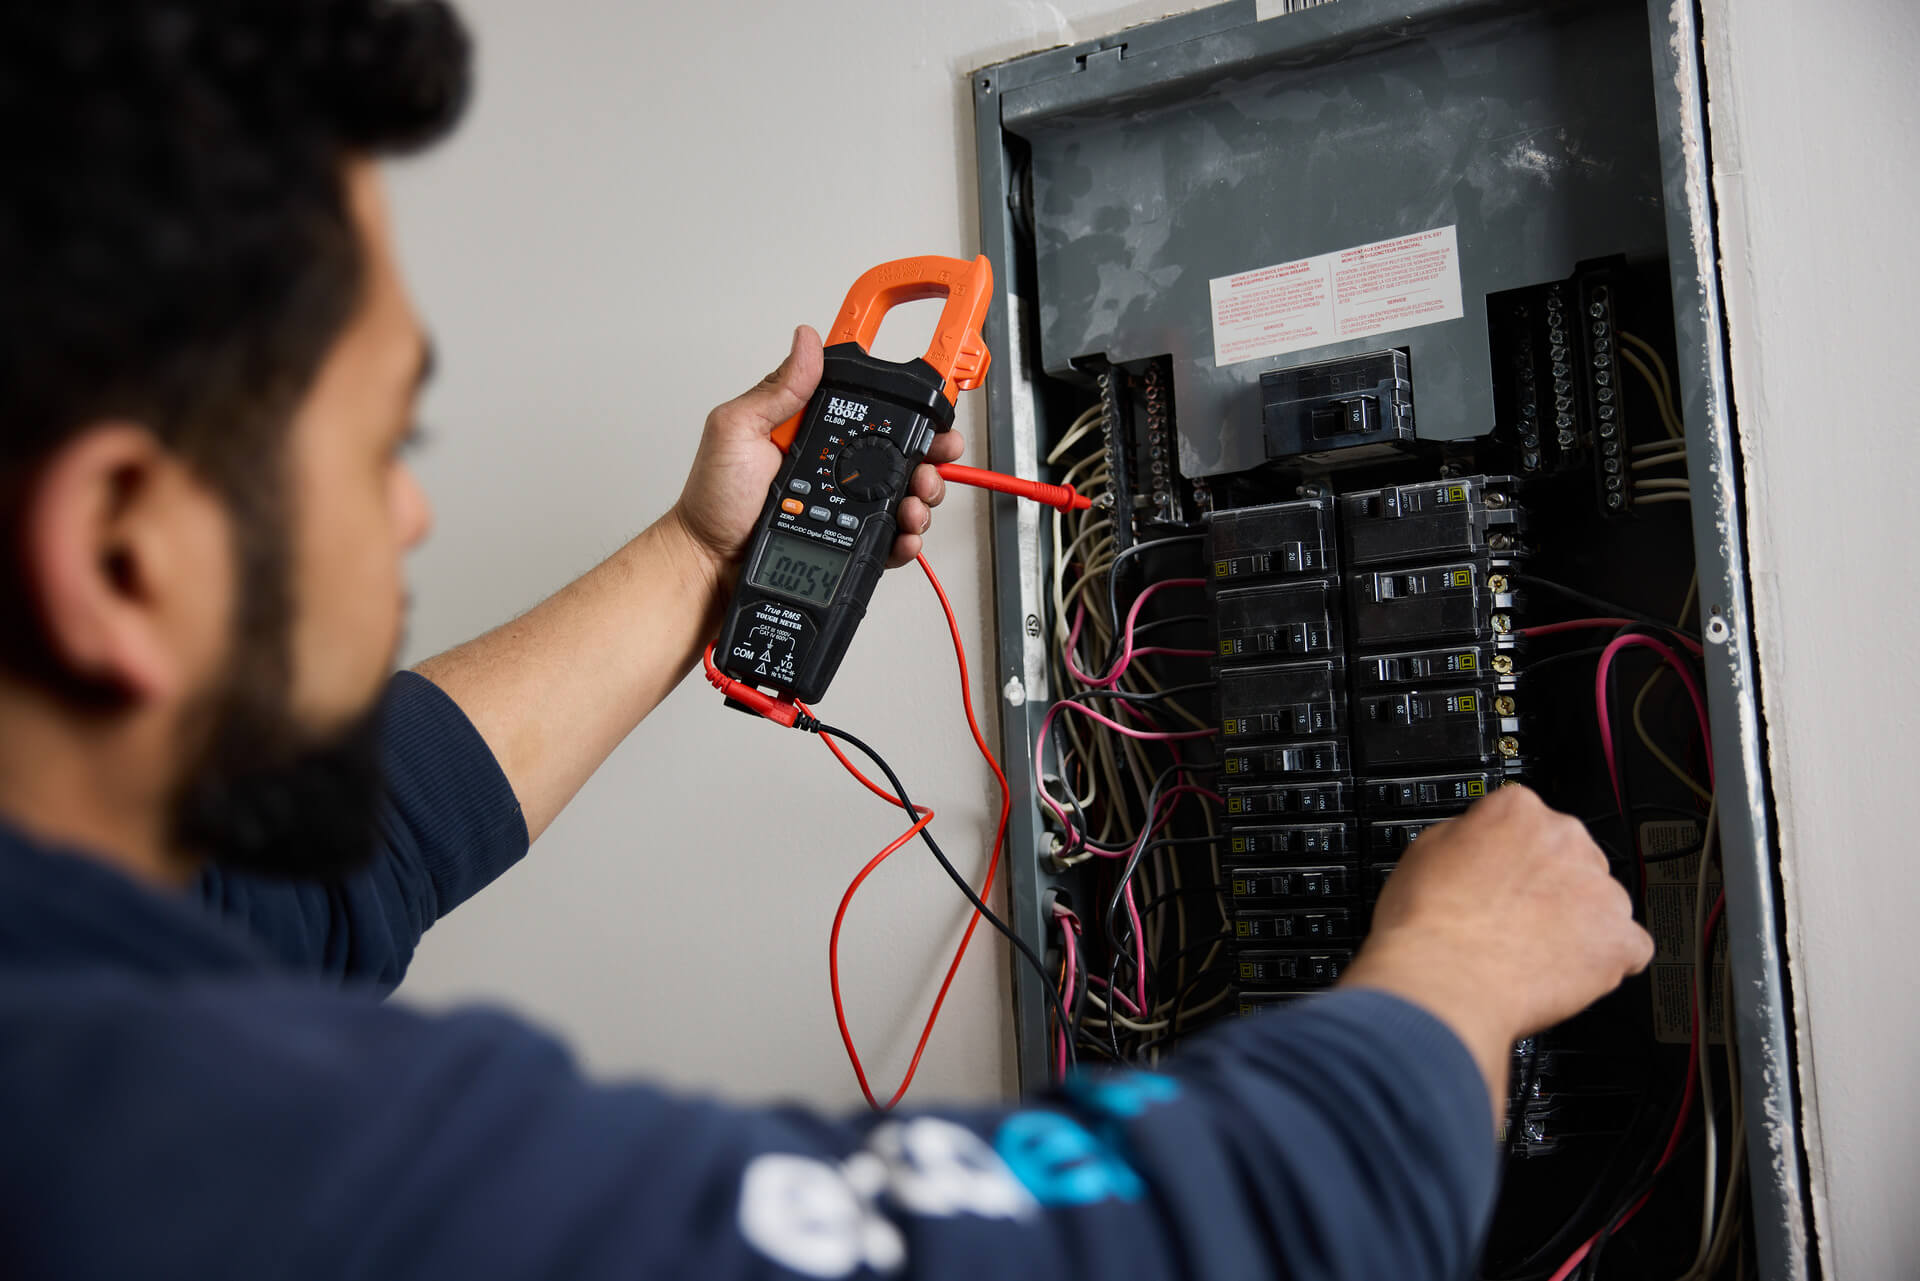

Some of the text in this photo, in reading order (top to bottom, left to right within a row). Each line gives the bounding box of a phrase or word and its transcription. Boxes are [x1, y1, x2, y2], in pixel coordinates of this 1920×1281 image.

[830, 397, 868, 415] KLEIN
[828, 405, 865, 422] TOOLS
[830, 496, 846, 504] OFF
[806, 529, 822, 538] Digital
[822, 534, 838, 544] Clamp
[838, 538, 852, 547] Meter
[836, 533, 854, 542] Counts
[1288, 552, 1296, 561] 20
[764, 604, 802, 620] True RMS
[756, 612, 802, 630] TOUGH METER
[760, 624, 770, 632] CAT
[733, 647, 755, 660] COM
[1396, 705, 1404, 714] 20
[1299, 716, 1306, 724] 15
[1403, 788, 1410, 798] 15
[1304, 796, 1311, 805] 15
[1308, 837, 1314, 847] 15
[1308, 881, 1316, 892] 15
[1312, 924, 1319, 933] 15
[1316, 966, 1323, 976] 15
